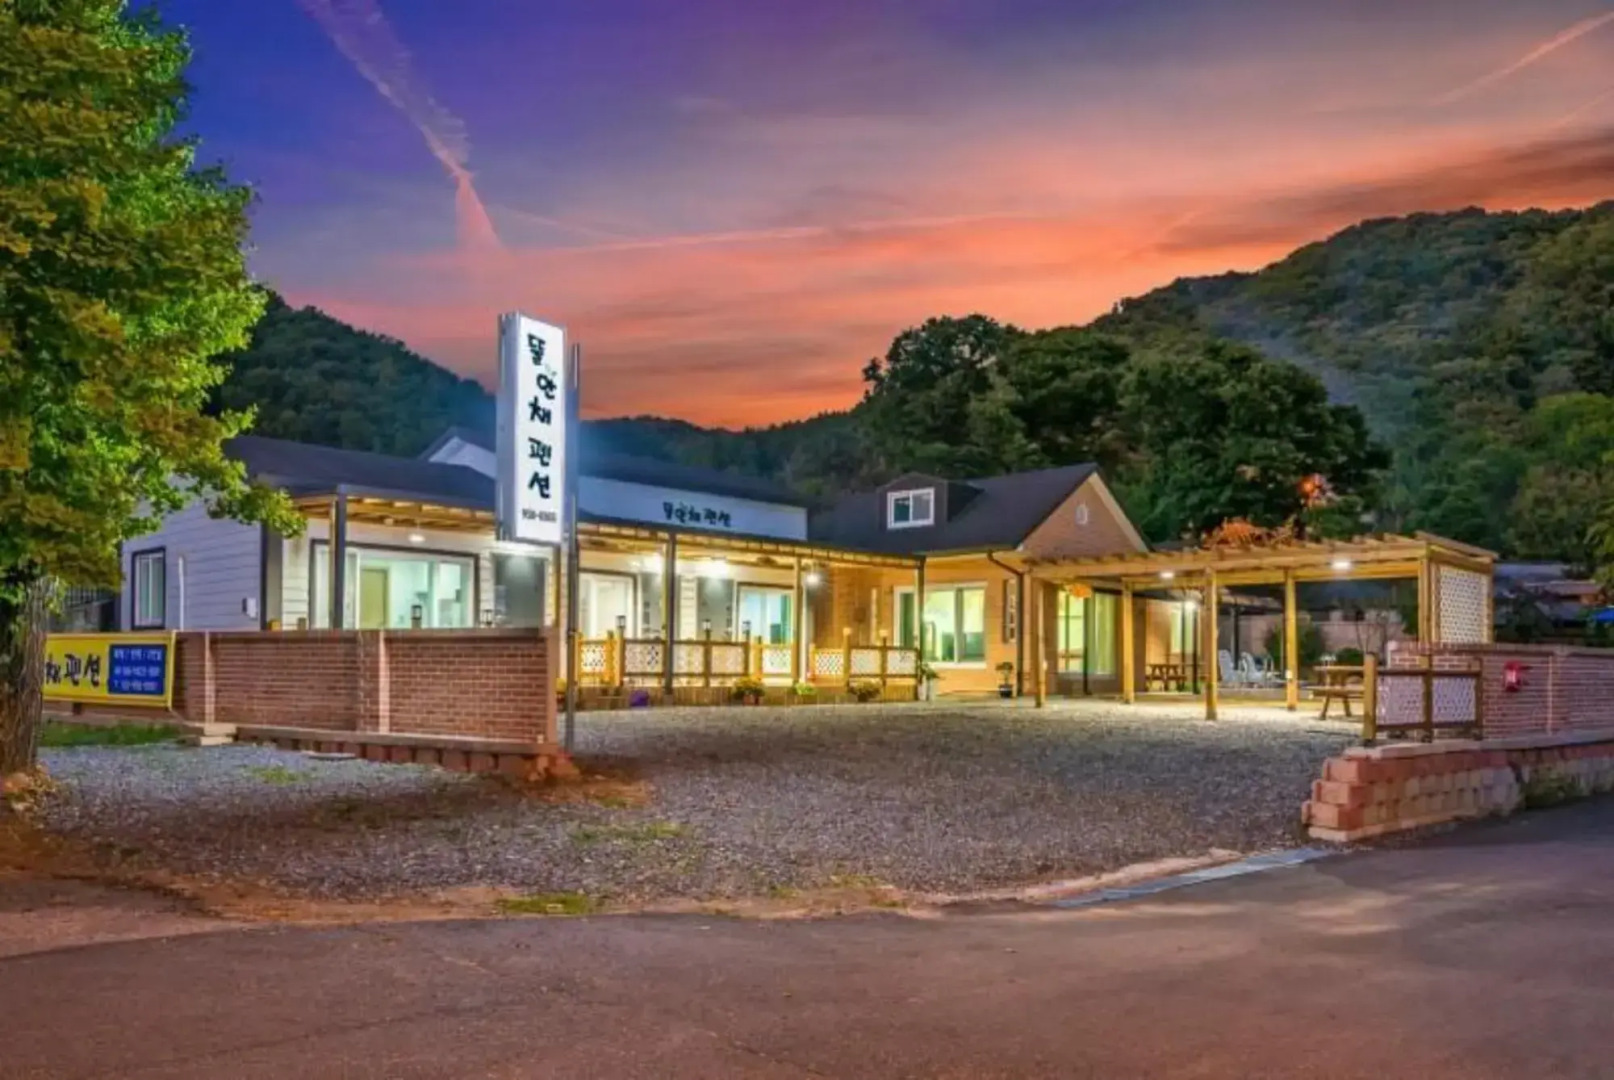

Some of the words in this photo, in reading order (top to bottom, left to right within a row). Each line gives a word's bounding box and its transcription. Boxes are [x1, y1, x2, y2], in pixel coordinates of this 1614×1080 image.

[527, 436, 552, 499] 펜션
[703, 507, 731, 527] 펜션
[64, 653, 100, 688] 펜션
